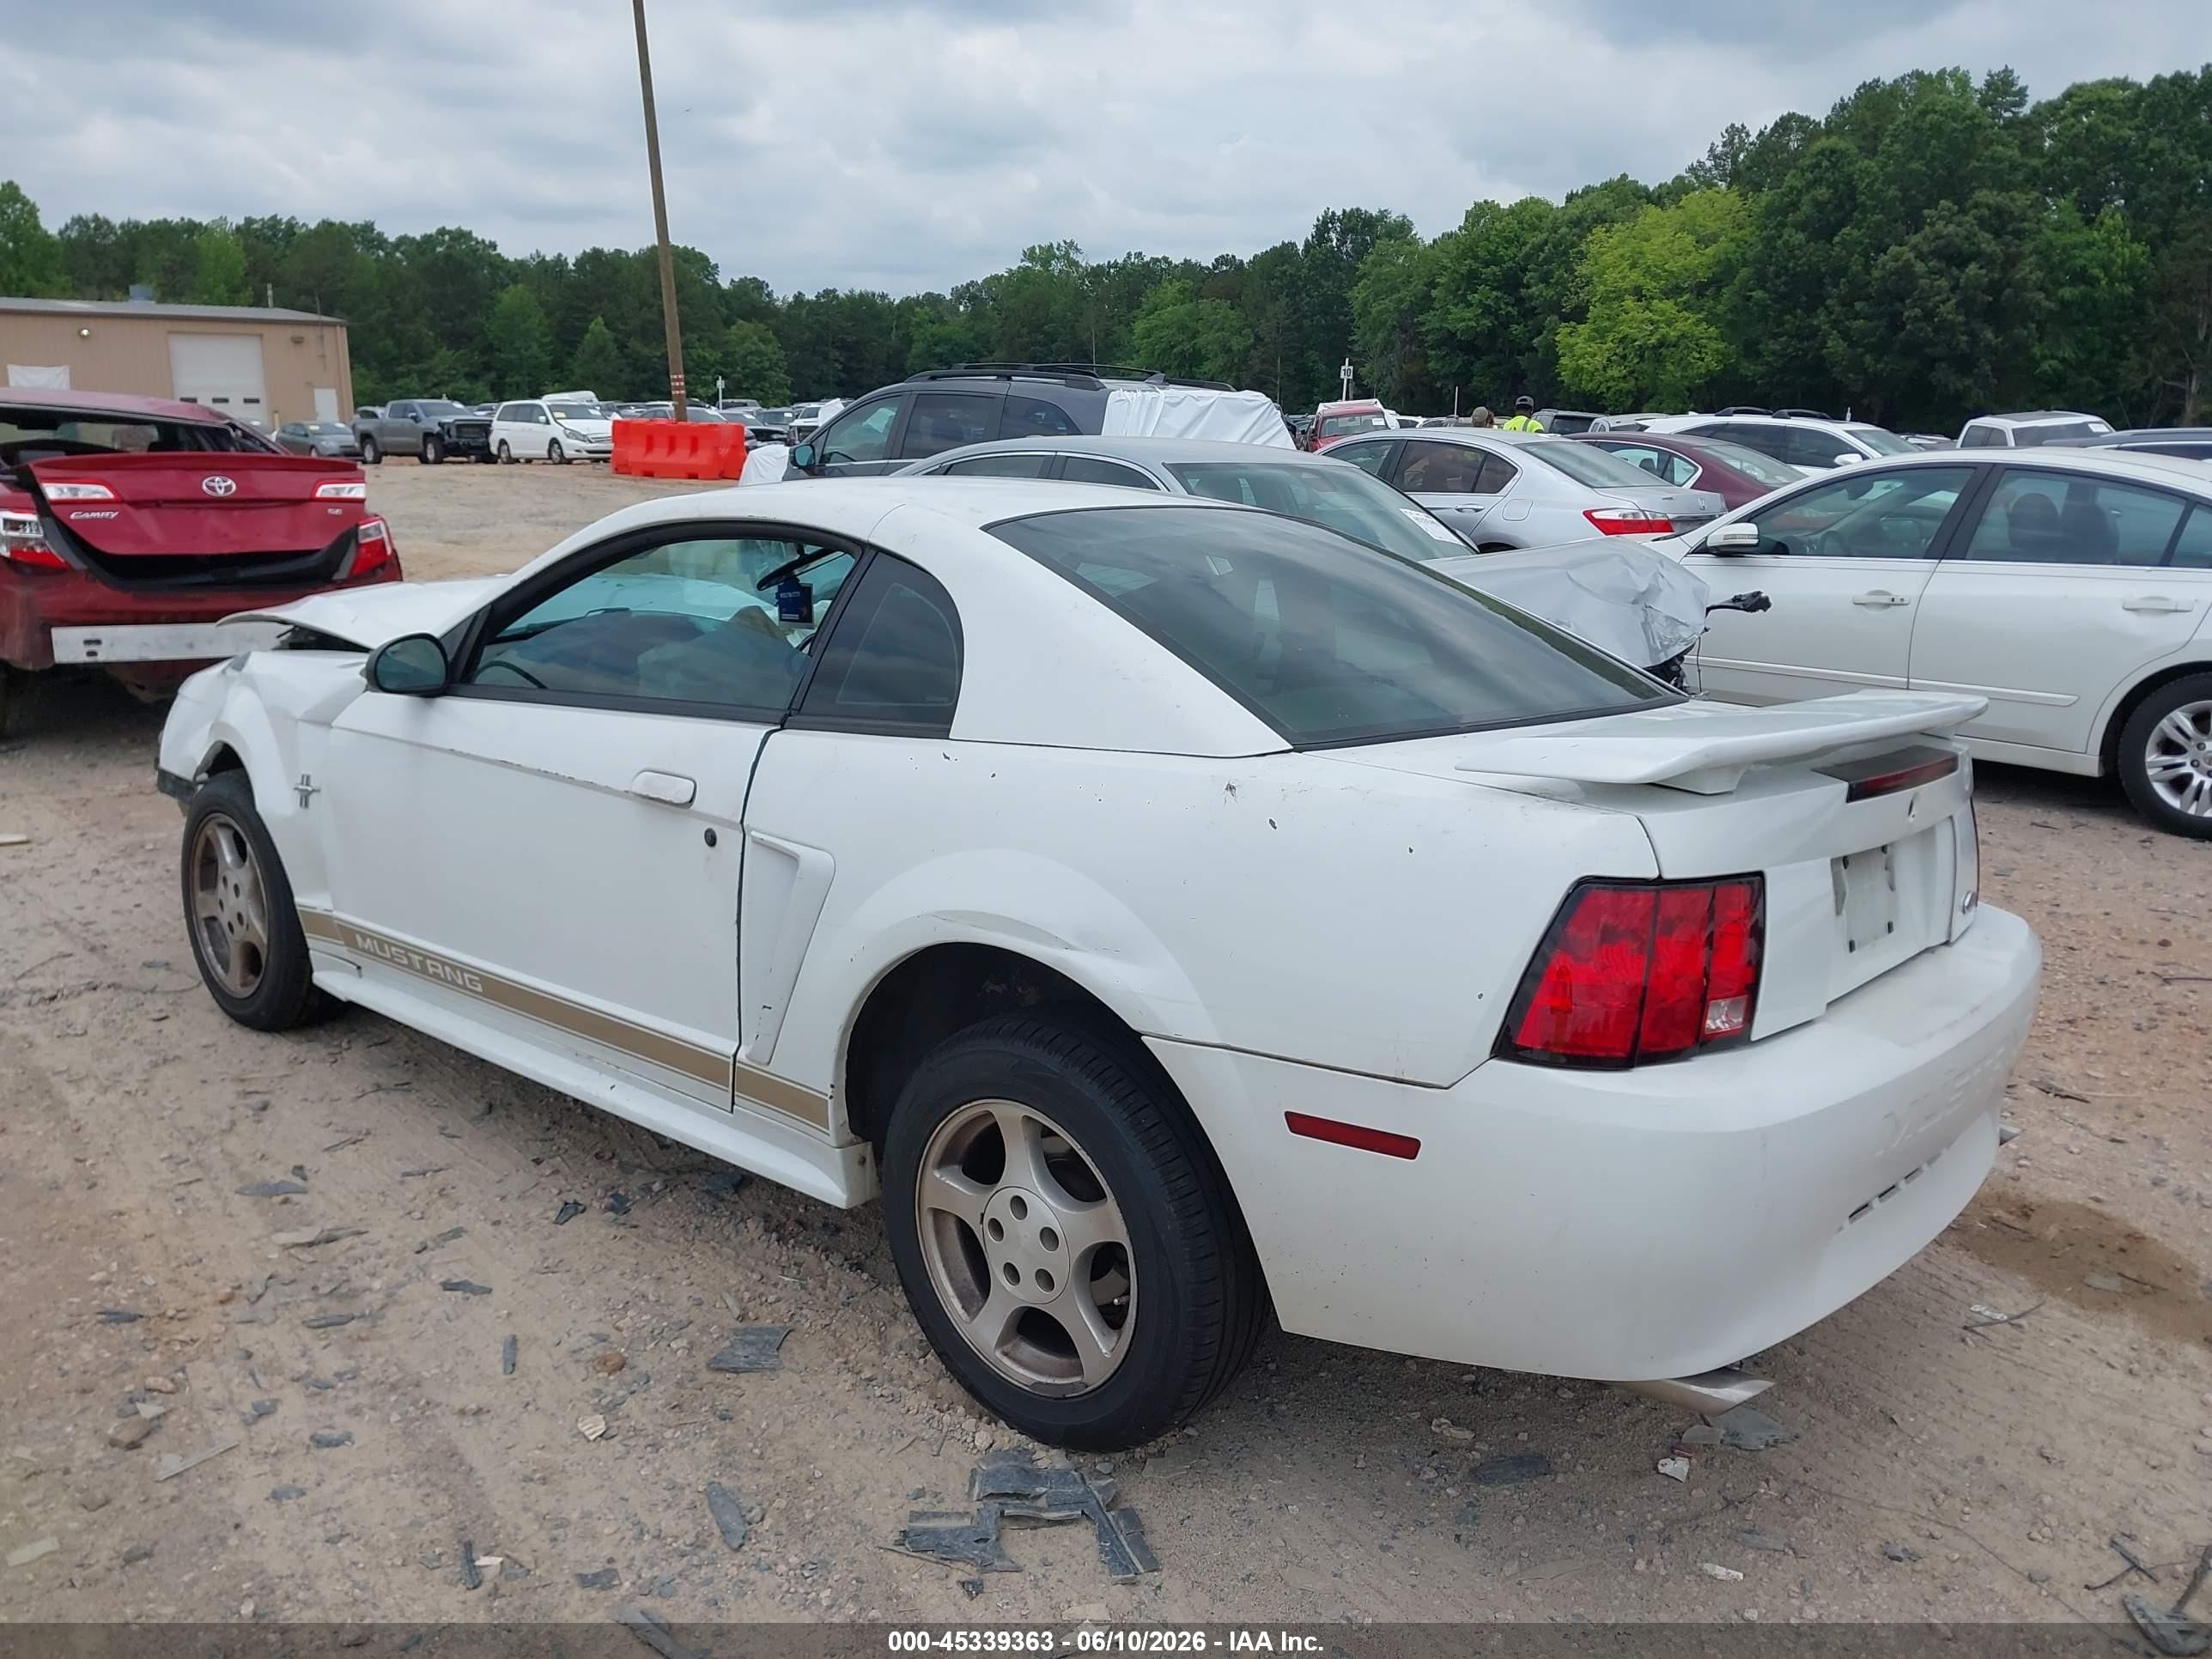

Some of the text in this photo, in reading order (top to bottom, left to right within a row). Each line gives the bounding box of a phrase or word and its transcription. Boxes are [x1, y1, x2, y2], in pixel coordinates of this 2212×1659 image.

[1342, 368, 1351, 377] 10
[70, 511, 119, 520] CAMRY
[356, 933, 483, 992] MUSTANG
